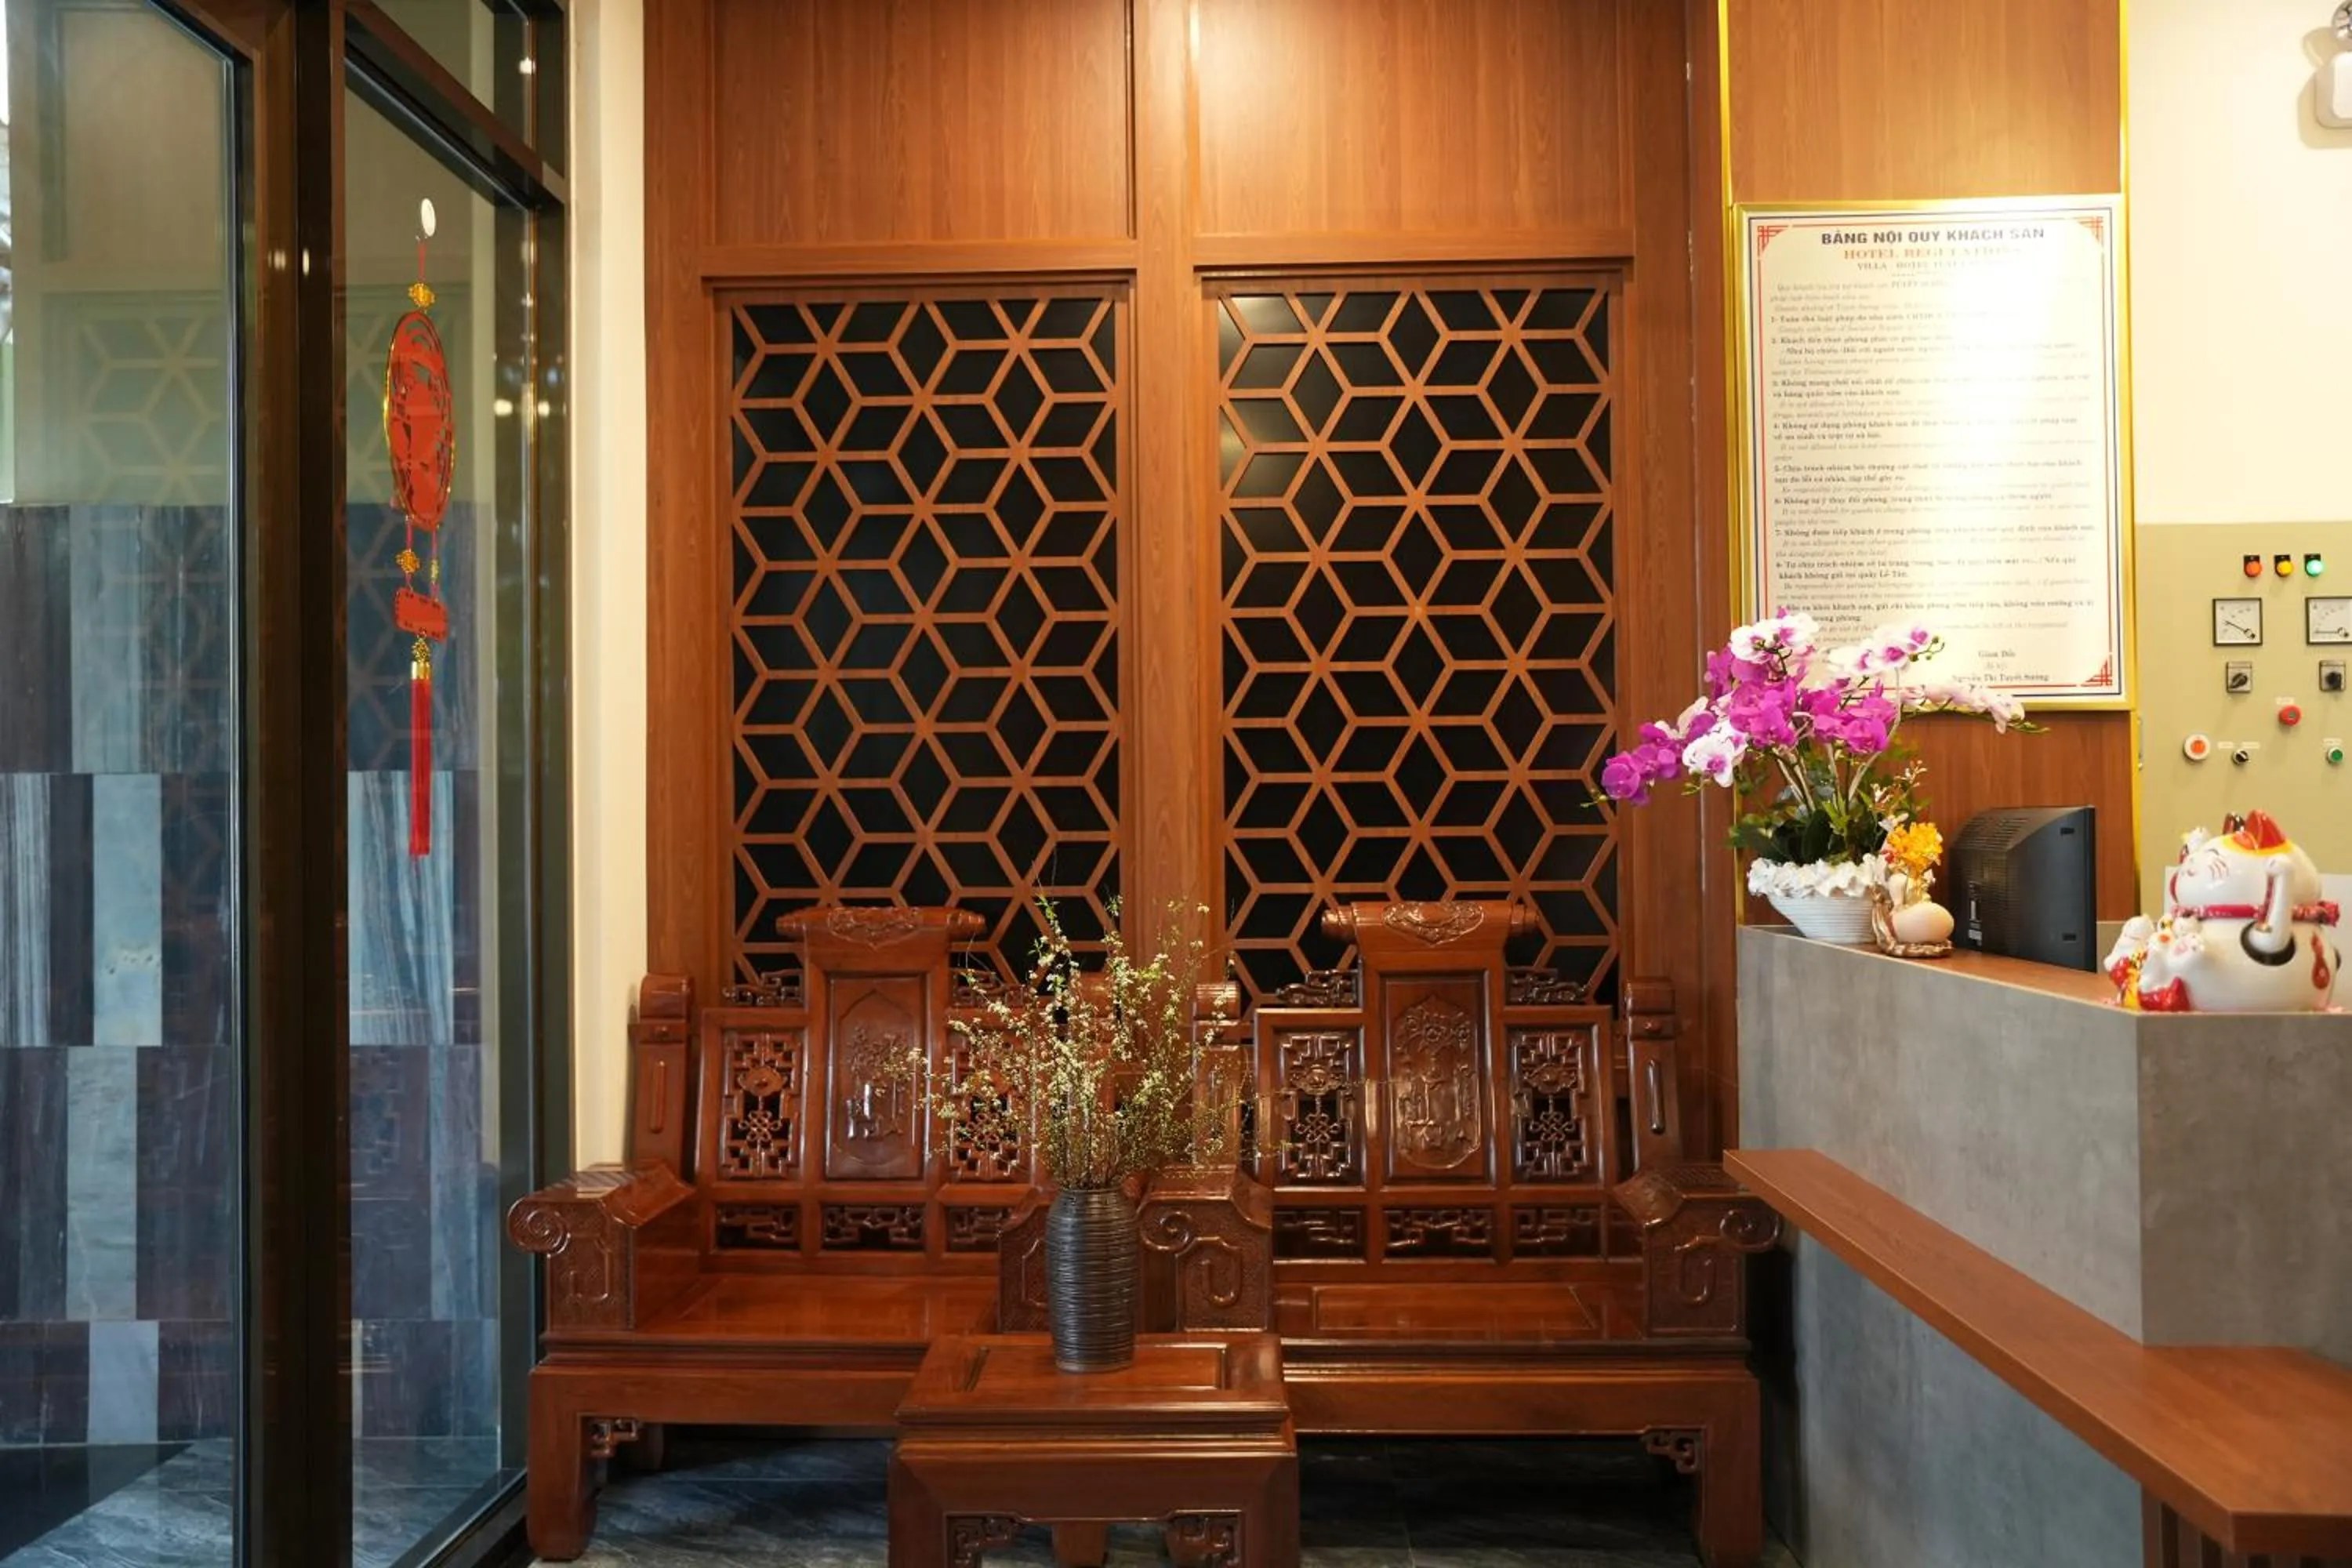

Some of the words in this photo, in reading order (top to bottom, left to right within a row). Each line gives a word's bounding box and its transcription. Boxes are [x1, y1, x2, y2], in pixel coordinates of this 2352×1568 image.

[1821, 230, 1867, 245] BẢNG
[1873, 230, 1902, 244] NỘI
[1844, 249, 1898, 260] HOTEL
